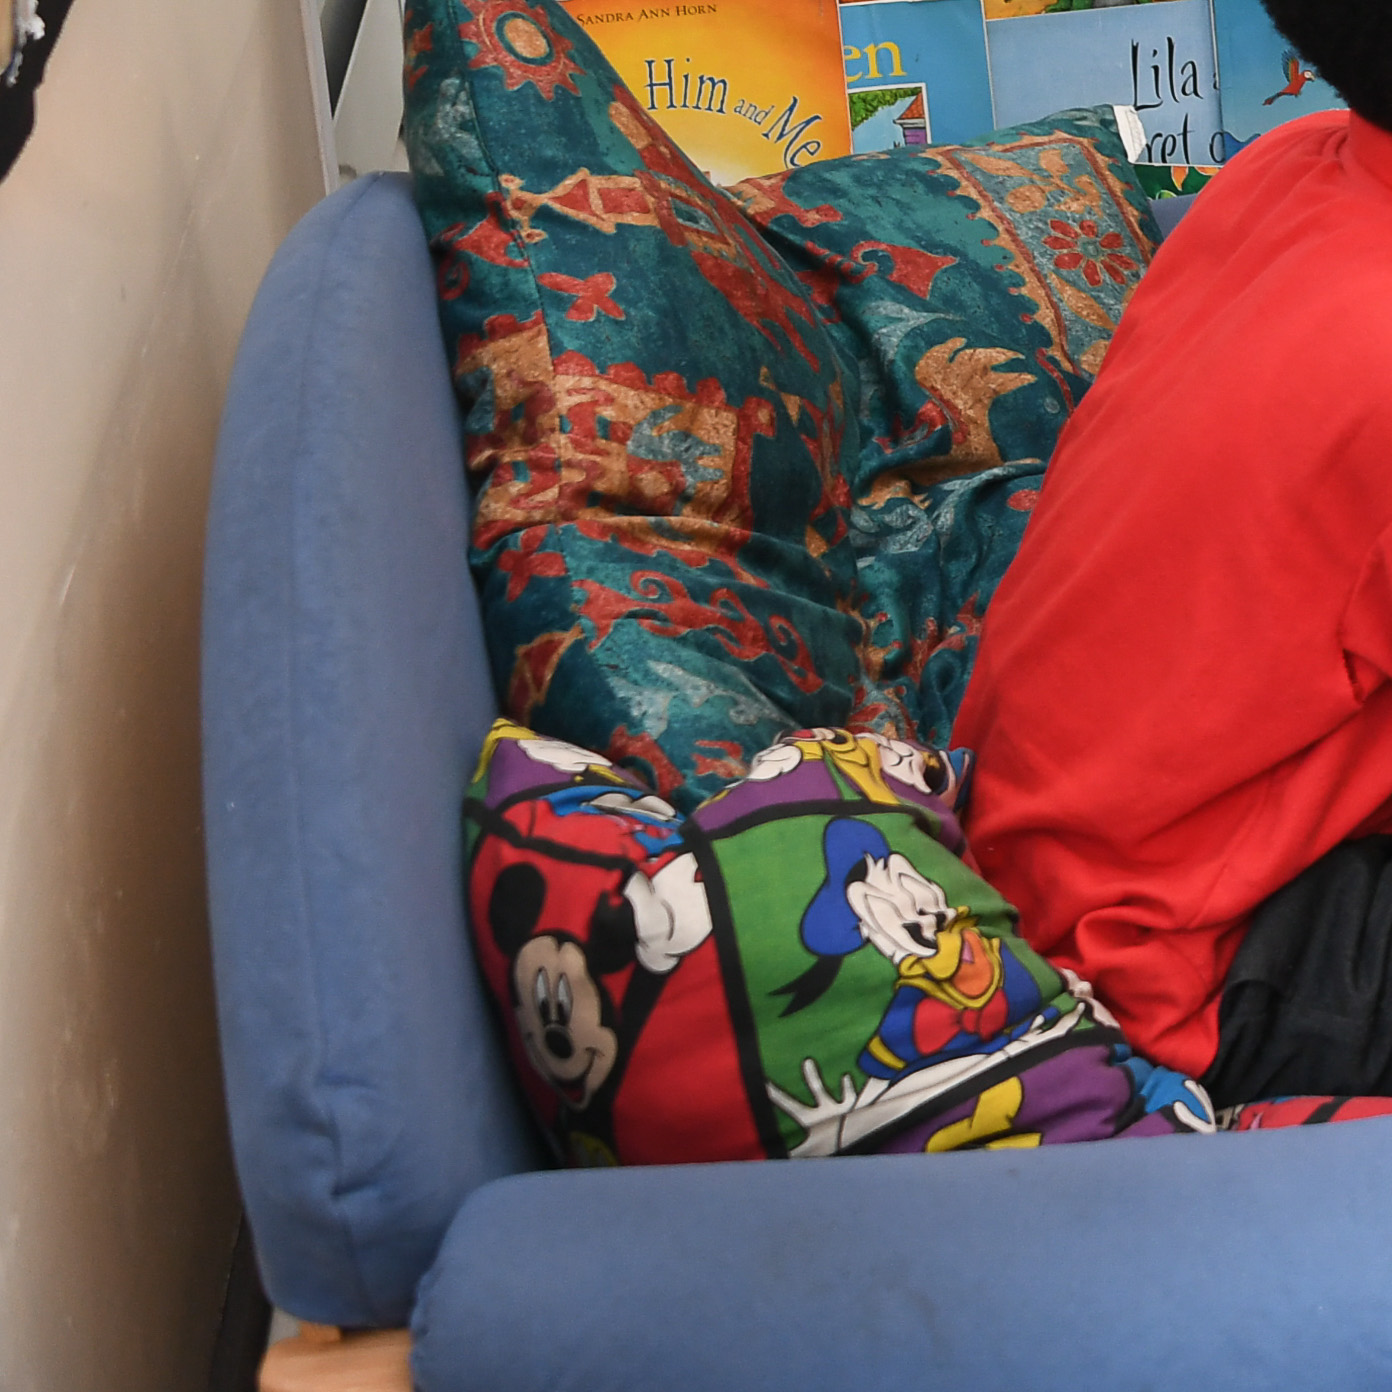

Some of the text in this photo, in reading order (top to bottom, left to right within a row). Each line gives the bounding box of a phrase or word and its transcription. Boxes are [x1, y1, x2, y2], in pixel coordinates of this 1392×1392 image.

[576, 4, 717, 26] SANDRA ANN HORN
[1131, 36, 1203, 111] Lila
[644, 57, 823, 169] Him and Me
